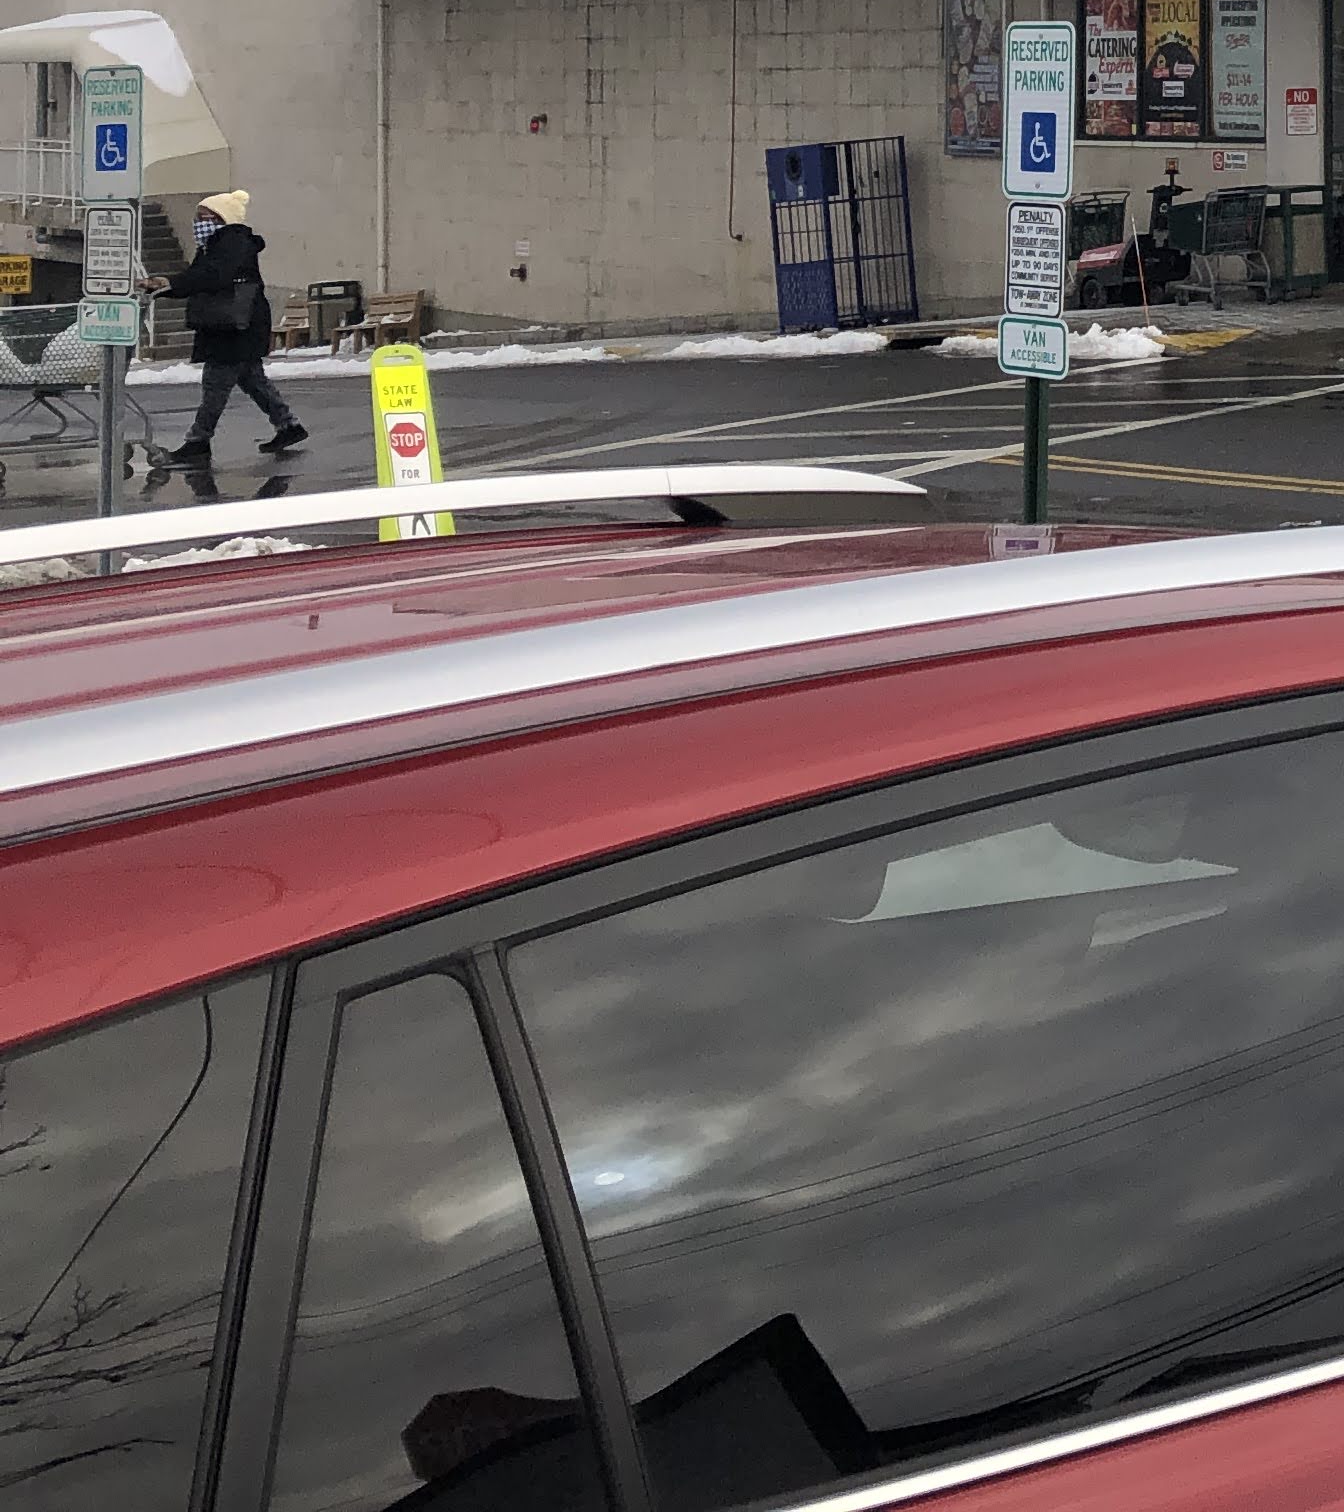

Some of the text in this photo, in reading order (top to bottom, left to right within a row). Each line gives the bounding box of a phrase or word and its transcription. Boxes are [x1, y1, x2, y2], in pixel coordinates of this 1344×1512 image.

[1162, 1, 1198, 23] LOCAL
[1011, 40, 1069, 62] RESERVED
[1088, 37, 1136, 57] CATERING
[87, 78, 137, 96] RESERVED
[1014, 70, 1065, 92] PARKING
[1235, 93, 1259, 107] HOUR
[1293, 91, 1310, 103] NO
[90, 100, 133, 118] PARKING
[1018, 210, 1054, 223] PENALTY
[1011, 259, 1020, 268] UP
[1022, 260, 1031, 269] TO
[1043, 262, 1059, 271] DAYS
[97, 305, 120, 321] VAN
[1023, 329, 1046, 347] VAN
[1010, 348, 1056, 364] ACCESSIBLE
[382, 384, 418, 396] STATE
[389, 398, 413, 408] LAW
[391, 433, 424, 448] STOP
[401, 469, 420, 479] FOR
